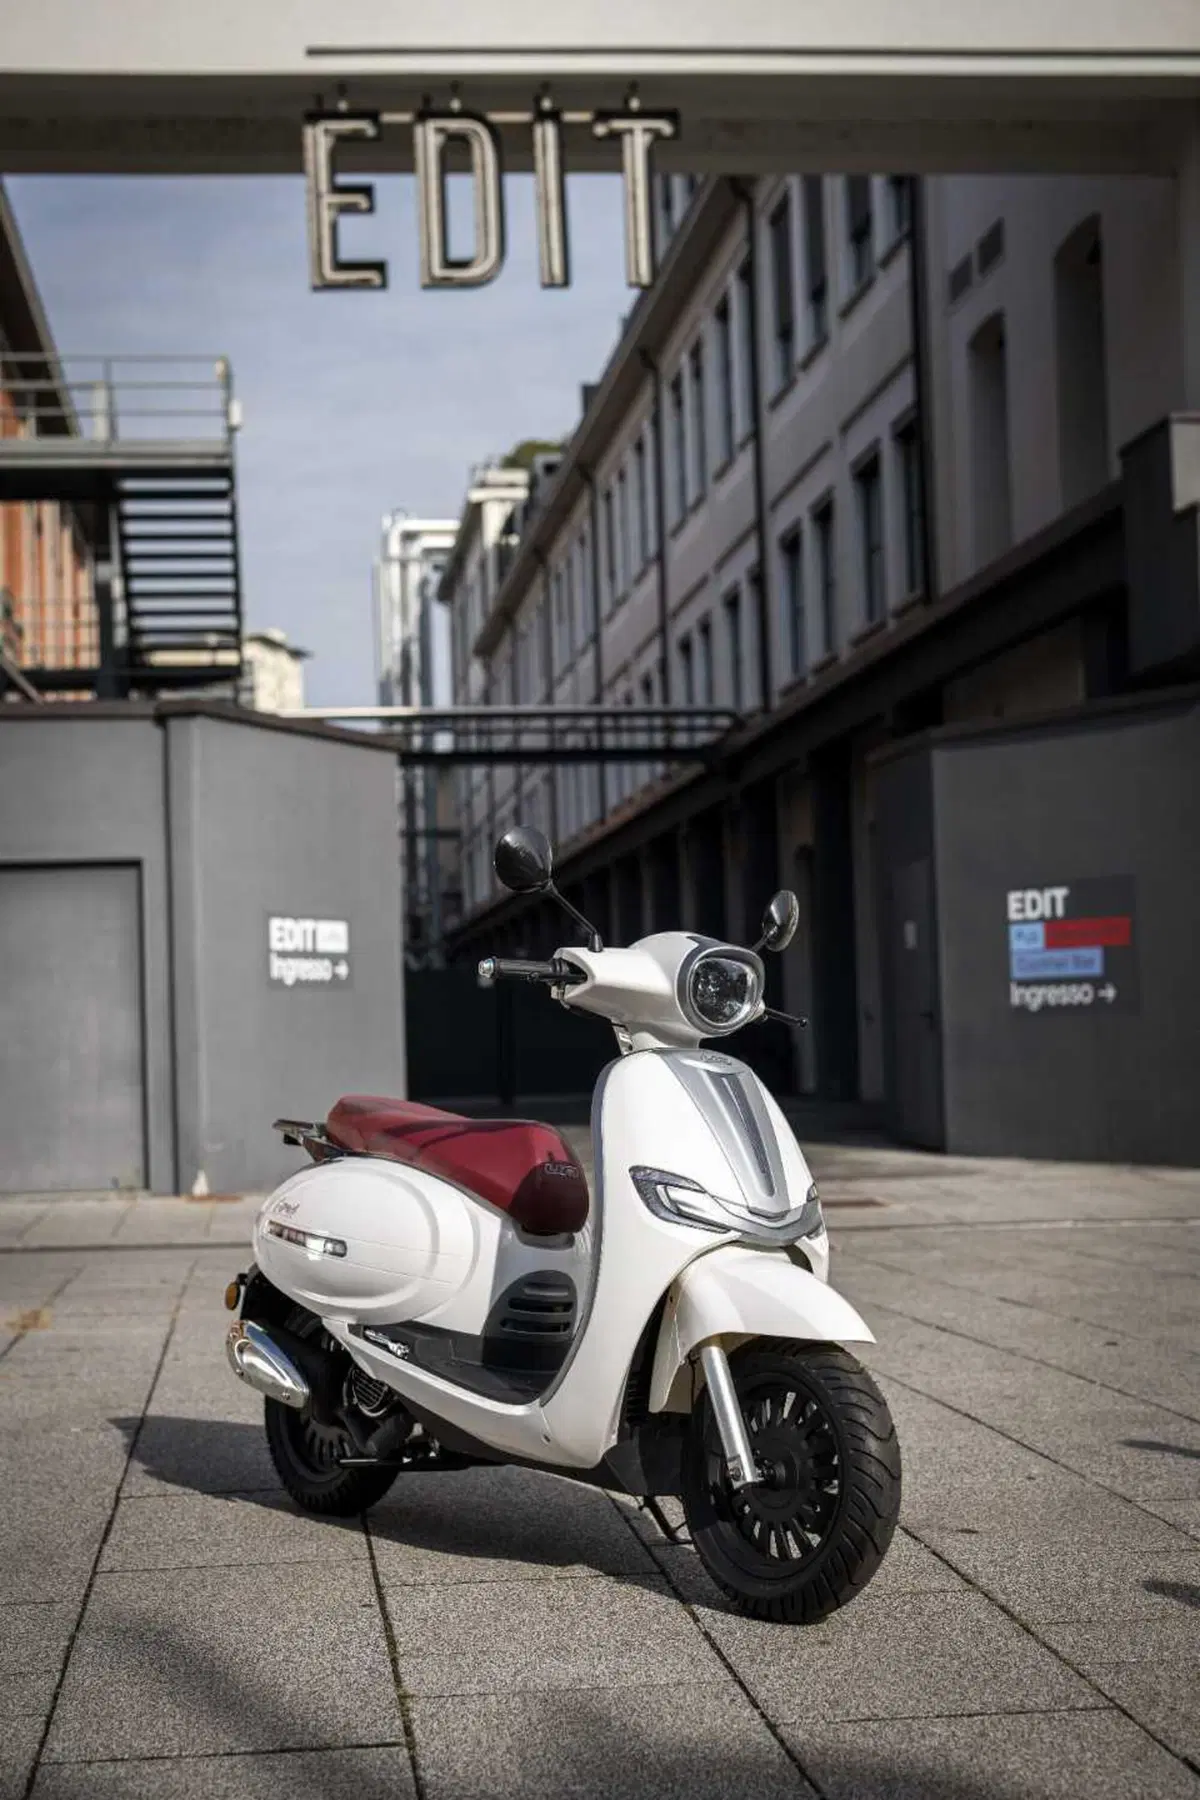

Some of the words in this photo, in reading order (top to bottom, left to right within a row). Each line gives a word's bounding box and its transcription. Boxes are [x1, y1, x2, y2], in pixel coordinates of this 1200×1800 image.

[303, 108, 680, 291] EDIT
[1007, 885, 1069, 921] EDIT
[268, 916, 317, 952] EDIT
[1010, 982, 1094, 1012] Ingresso
